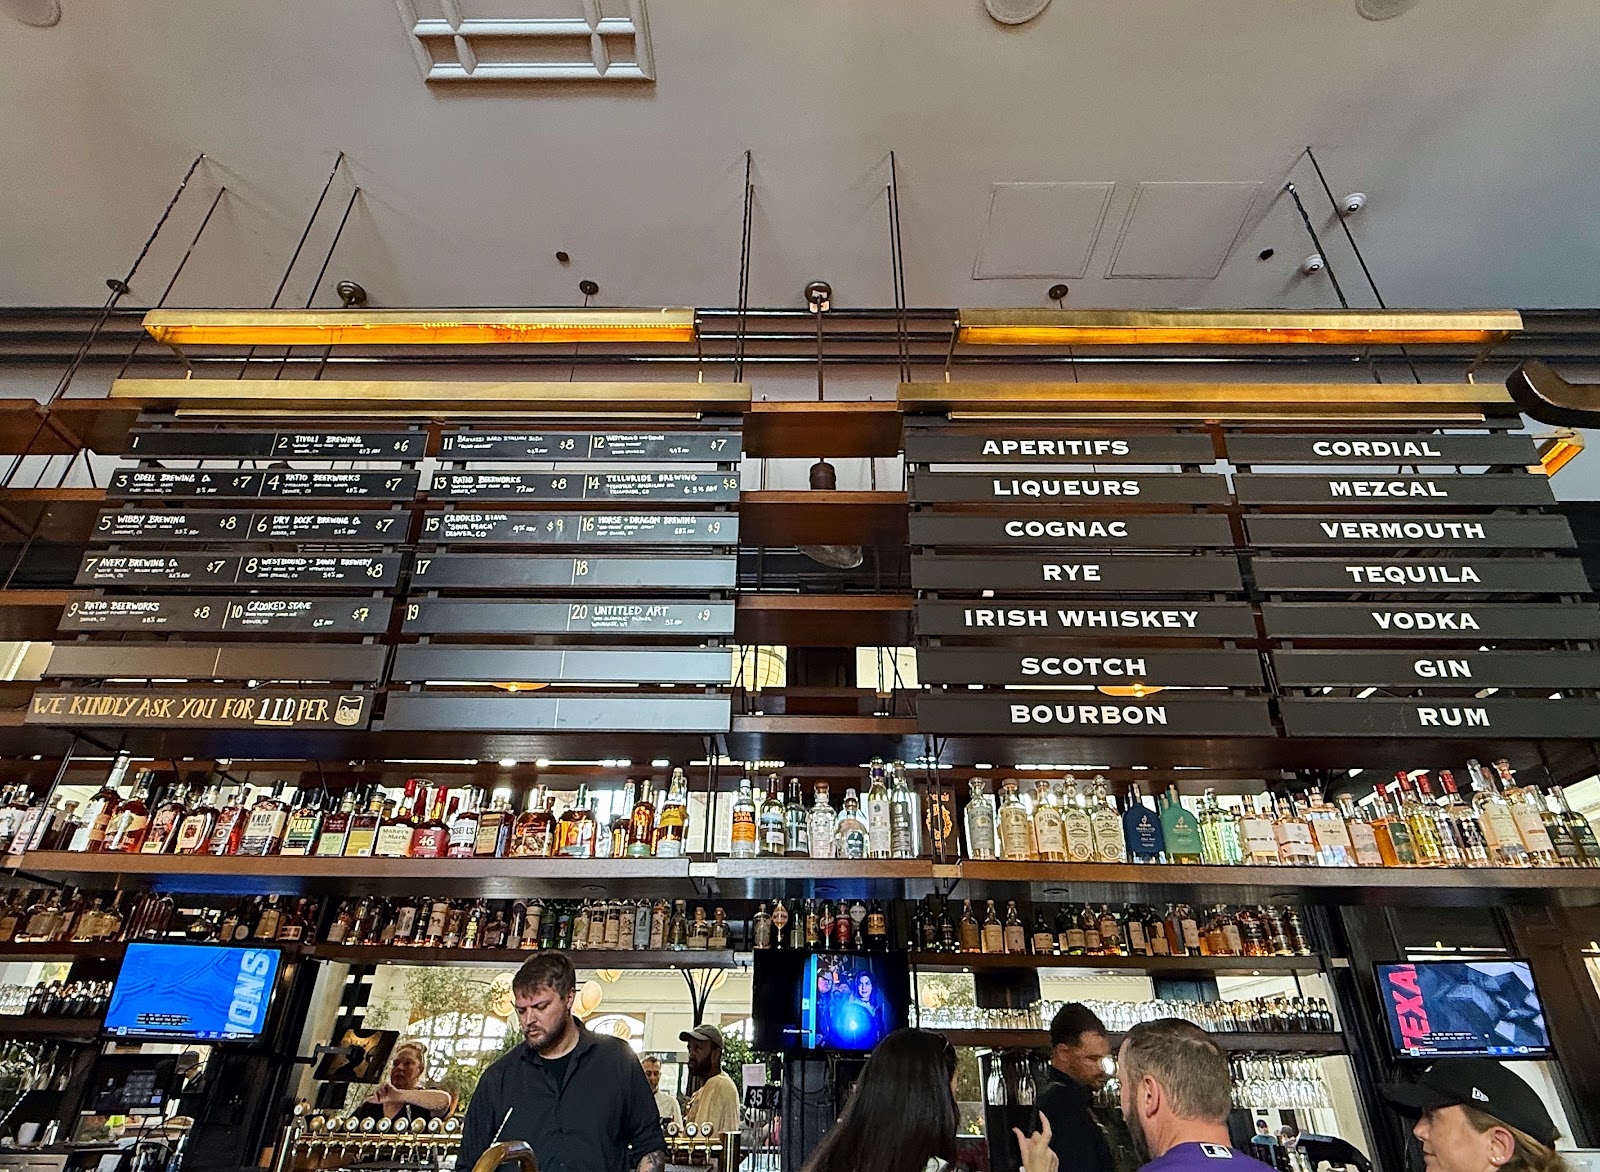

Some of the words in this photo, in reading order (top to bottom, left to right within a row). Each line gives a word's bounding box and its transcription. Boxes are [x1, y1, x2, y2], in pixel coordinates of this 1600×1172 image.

[132, 436, 140, 448] 1
[278, 437, 288, 448] 2
[394, 440, 410, 452] $6
[443, 438, 454, 450] 11
[559, 439, 574, 450] $8
[594, 437, 604, 448] 12
[710, 440, 728, 452] $7
[982, 440, 1130, 455] APERITIFS
[1312, 442, 1442, 456] CORDIAL
[116, 475, 128, 488] 3
[134, 474, 156, 482] ODELL
[160, 474, 196, 482] BREWING
[232, 476, 252, 488] $7
[267, 474, 280, 490] 4
[313, 474, 360, 482] BEERWORKS
[385, 478, 402, 492] $7
[434, 476, 447, 490] 13
[452, 476, 474, 484] RATIO
[478, 476, 522, 484] BEERWORKS
[552, 478, 567, 490] $8
[588, 476, 600, 490] 14
[722, 478, 738, 490] $8
[993, 480, 1140, 498] LIQUEURS
[1329, 482, 1448, 497] MEZCAL
[99, 516, 112, 530] 5
[117, 515, 146, 524] WIBBY
[148, 515, 186, 524] BREWING
[220, 516, 236, 530] $8
[257, 516, 268, 532] 6
[272, 516, 290, 524] DRY
[294, 516, 314, 524] DOCK
[317, 516, 348, 524] BREWING
[375, 518, 394, 532] $7
[425, 518, 440, 532] 15
[444, 514, 482, 522] CROOKED
[582, 517, 594, 532] 16
[598, 516, 622, 524] HORSE
[664, 516, 696, 524] BREWING
[708, 522, 721, 534] $9
[1004, 521, 1128, 537] COGNAC
[1320, 522, 1486, 539] VERMOUTH
[84, 558, 98, 572] 7
[99, 558, 126, 567] AVERY
[128, 558, 164, 567] BREWING
[206, 560, 226, 574] $7
[245, 558, 258, 573] 8
[340, 558, 373, 568] BREWERY
[366, 564, 384, 578] $8
[416, 560, 431, 574] 17
[576, 560, 588, 576] 18
[1043, 564, 1101, 581] RYE
[1346, 566, 1481, 585] TEQUILA
[68, 602, 78, 618] 9
[84, 602, 107, 610] RATIO
[110, 602, 160, 612] BEERWORKS
[193, 606, 210, 619] $8
[230, 605, 243, 618] 10
[247, 602, 286, 611] CROOKED
[288, 602, 312, 610] STAVE
[352, 608, 369, 622] $7
[406, 604, 420, 620] 19
[571, 604, 588, 620] 20
[594, 606, 642, 616] UNTITLED
[646, 606, 670, 616] ART
[698, 609, 710, 621] $9
[964, 610, 1048, 627] IRISH
[1057, 610, 1198, 628] WHISKEY
[1372, 612, 1480, 630] VODKA
[1021, 657, 1147, 676] SCOTCH
[1414, 660, 1472, 678] GIN
[34, 696, 66, 714] WE
[68, 696, 140, 717] KINDLY
[138, 698, 176, 718] ASK
[176, 698, 214, 719] YOU
[220, 698, 254, 720] FOR
[258, 698, 270, 720] 1
[296, 698, 330, 722] PER
[1010, 704, 1168, 725] BOURBON
[1416, 708, 1490, 727] RUM
[750, 1088, 762, 1106] 35
